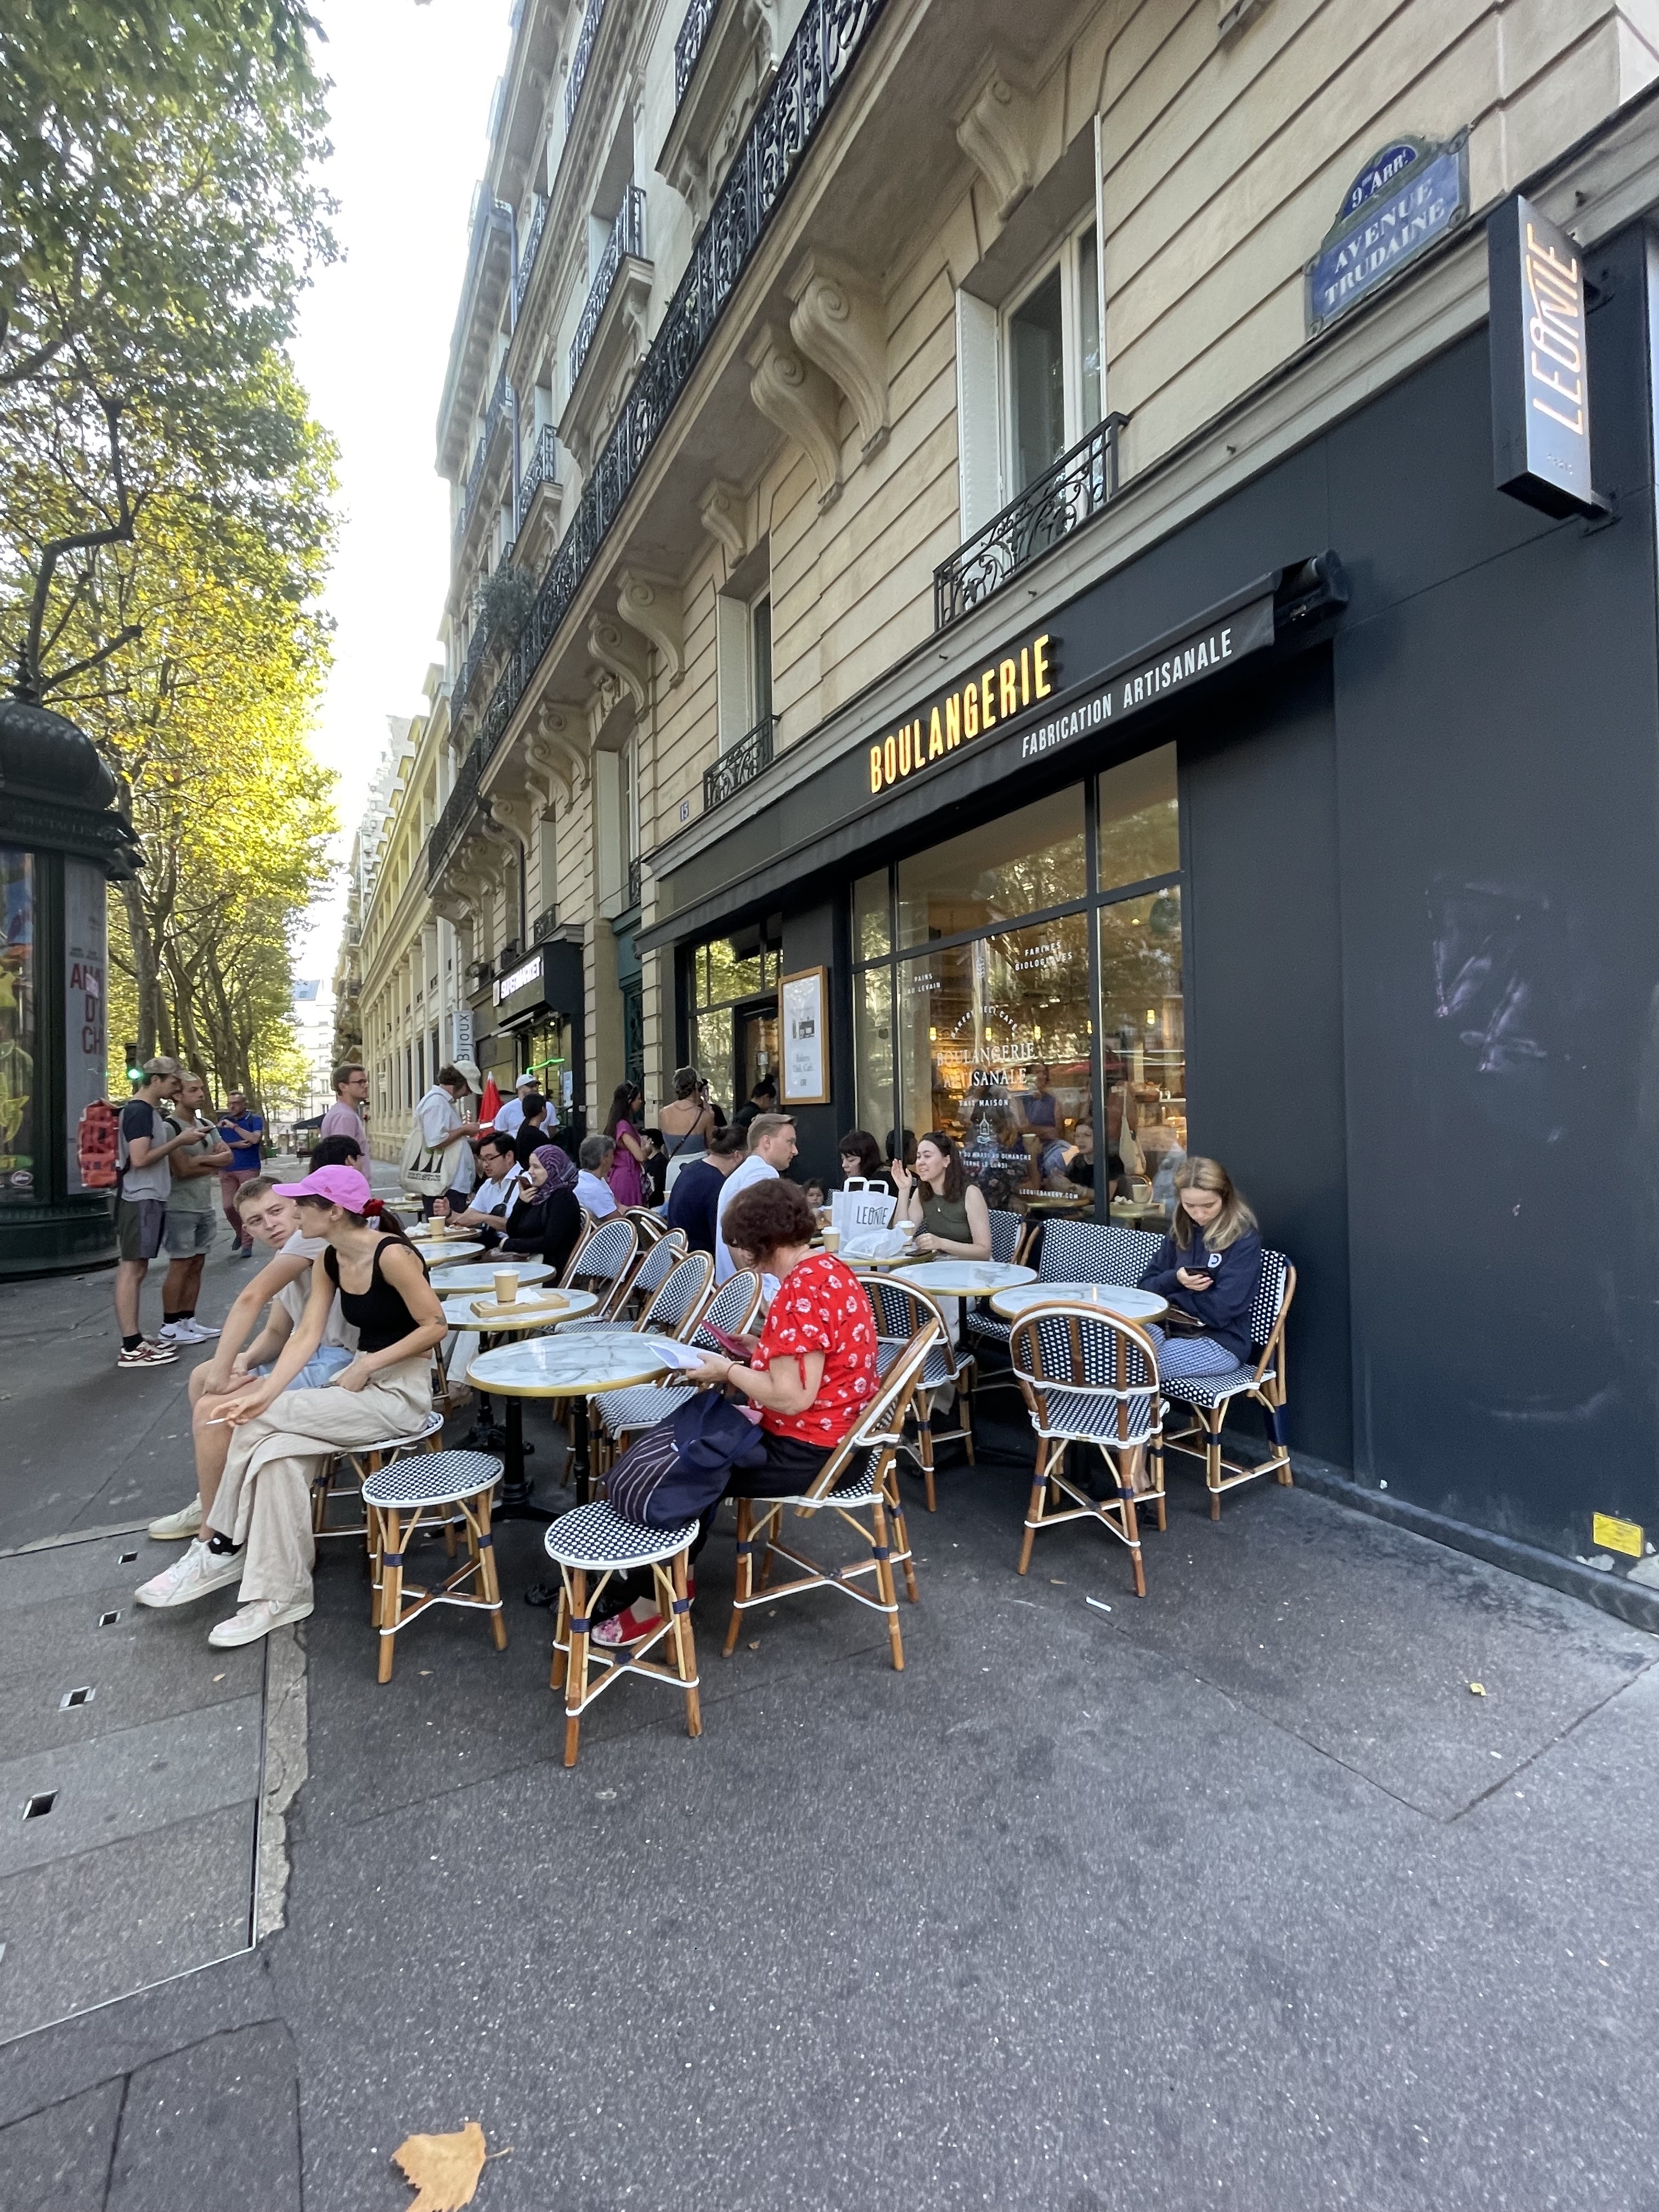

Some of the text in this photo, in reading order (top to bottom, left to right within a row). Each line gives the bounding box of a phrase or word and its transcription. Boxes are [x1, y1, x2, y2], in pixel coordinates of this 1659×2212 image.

[1324, 198, 1444, 306] TRUDAINE
[1334, 177, 1432, 274] AVENUE
[870, 634, 1051, 794] BOULANGERIE
[1022, 628, 1232, 758] FABRICATION ARTISANALE
[917, 982, 940, 992] LEVAIN
[1024, 940, 1062, 957] FARINES
